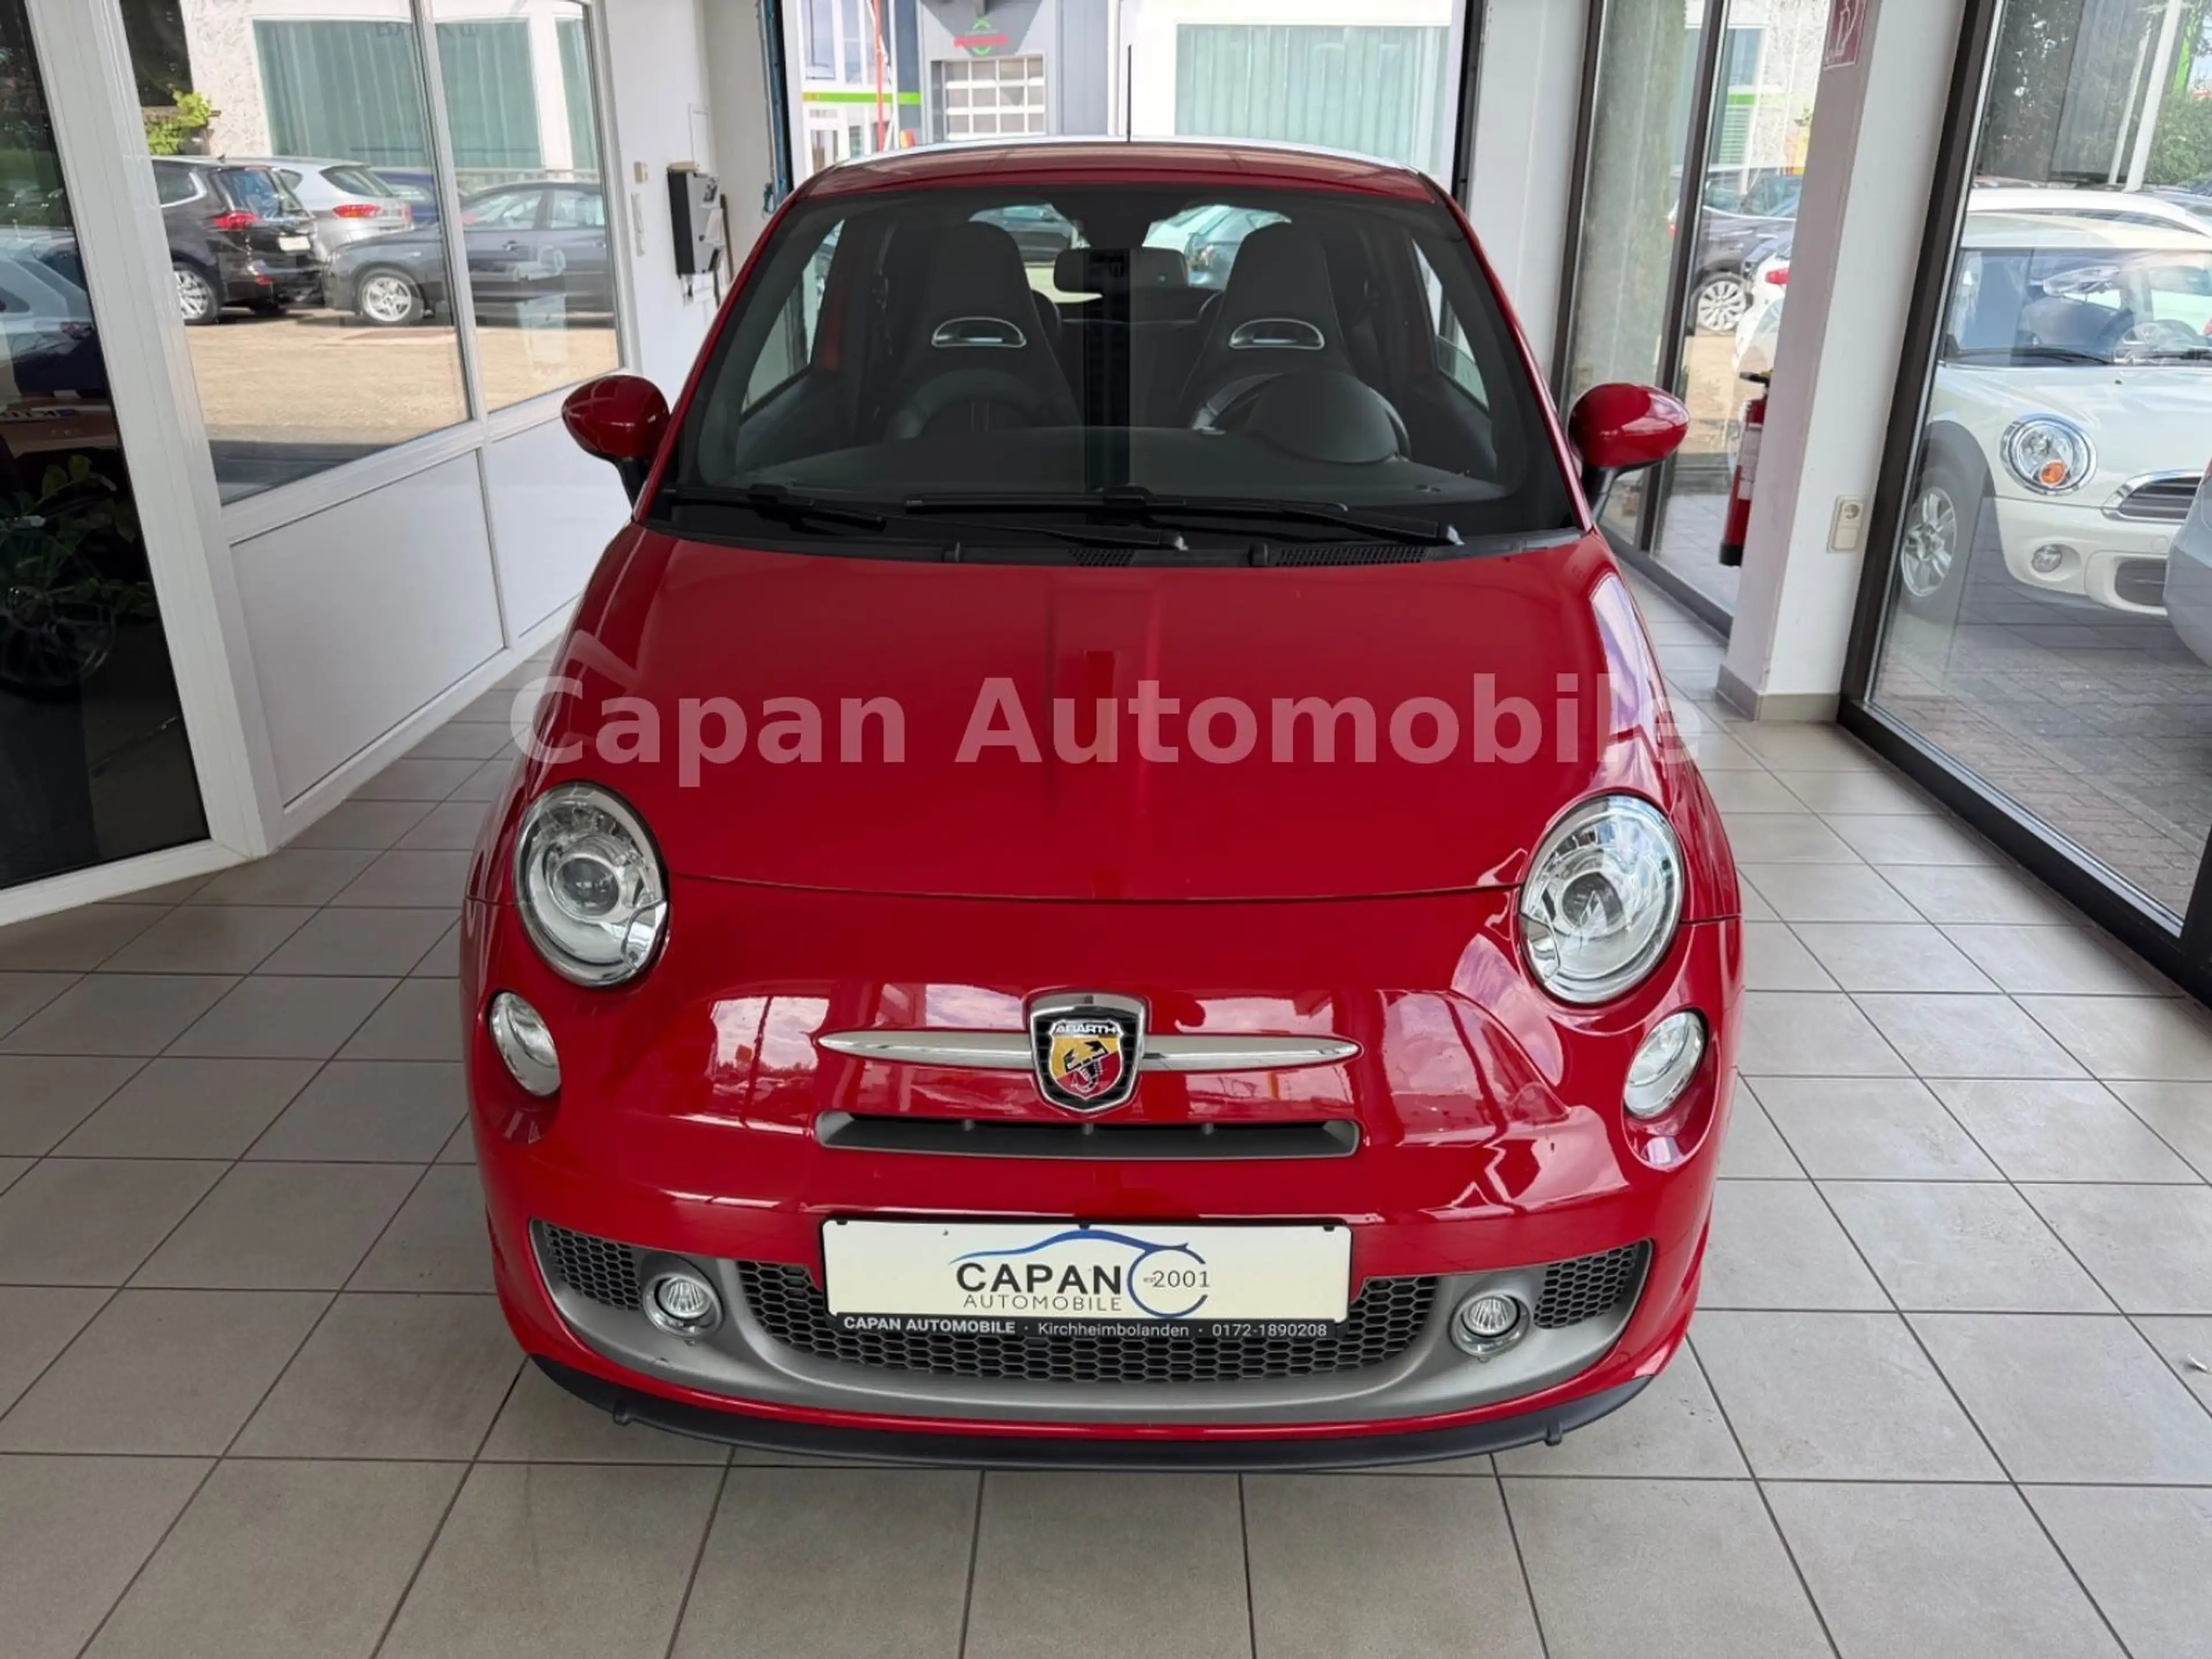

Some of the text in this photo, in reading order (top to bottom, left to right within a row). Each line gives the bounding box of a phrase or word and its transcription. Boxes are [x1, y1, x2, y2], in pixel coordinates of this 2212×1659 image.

[1055, 1024, 1117, 1033] ABARTH
[956, 1262, 1121, 1295] CAPAN
[1152, 1270, 1211, 1288] 2001
[963, 1294, 1122, 1311] AUTOMOBILE
[843, 1316, 1327, 1337] CAPAN AUTOMOBILE Kirchheimbolanden 0172-1890208
